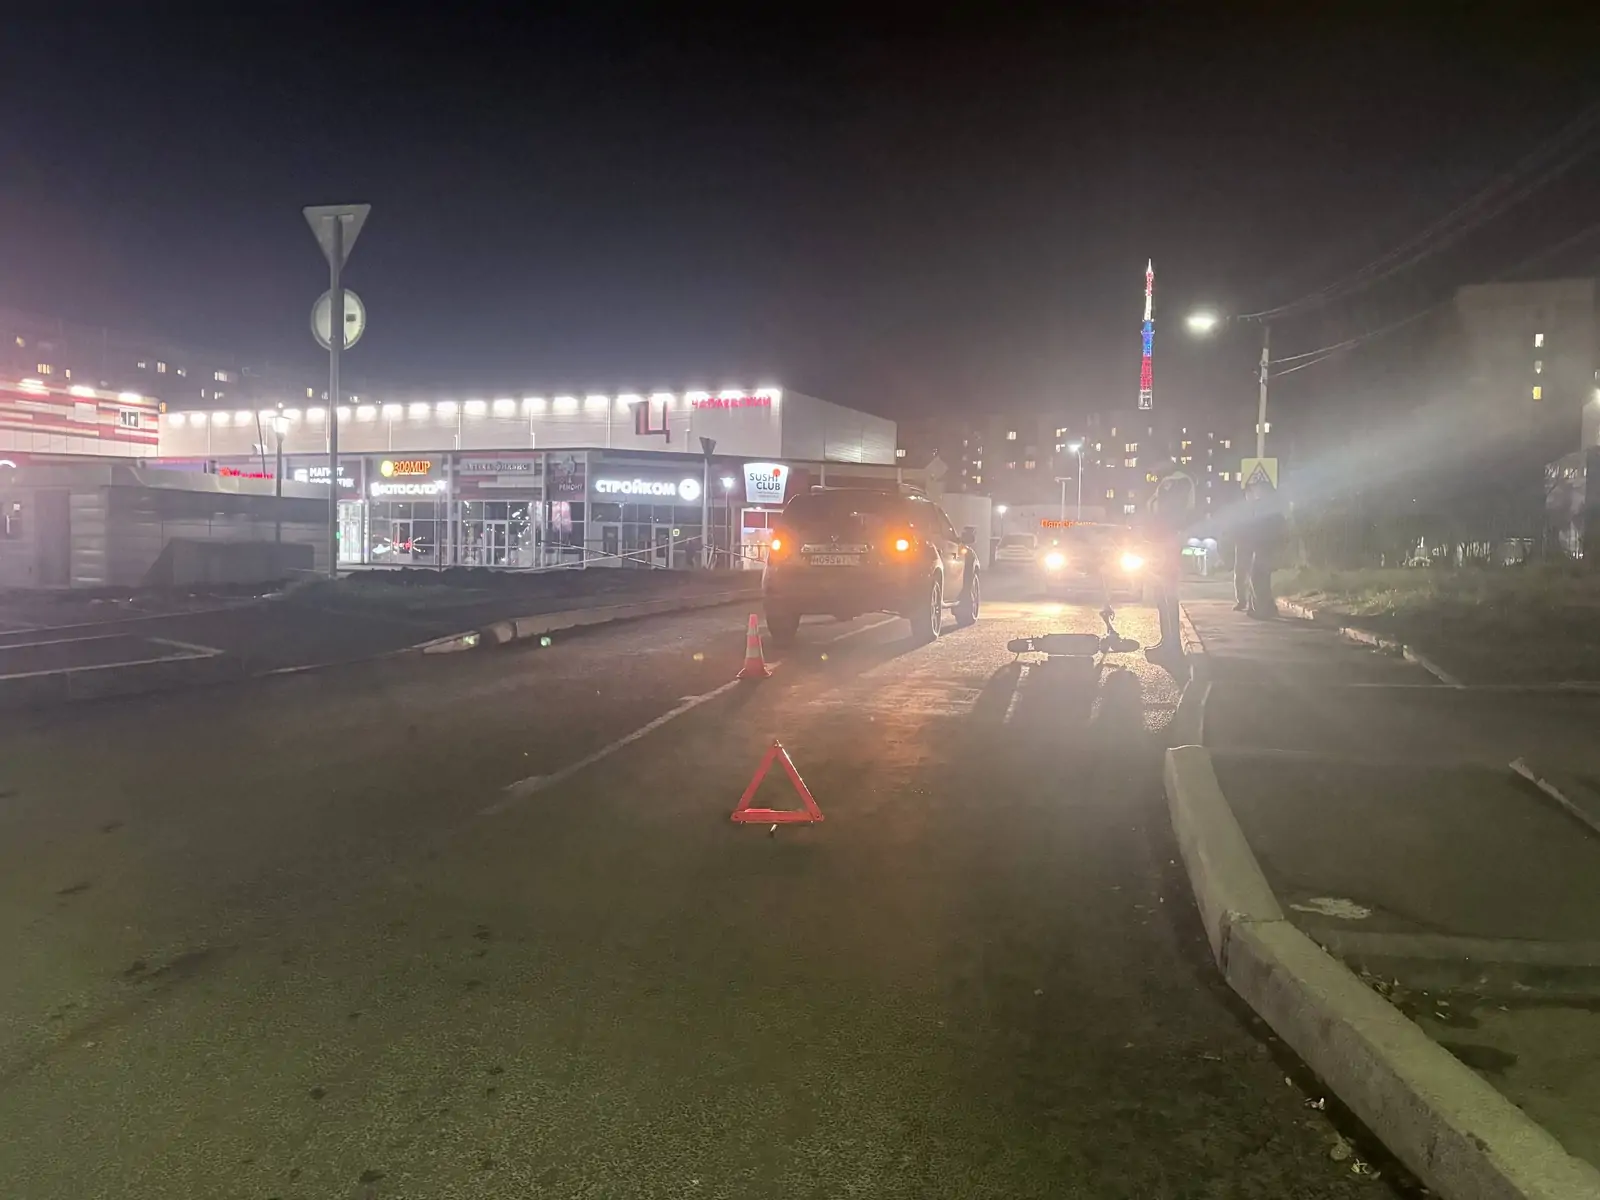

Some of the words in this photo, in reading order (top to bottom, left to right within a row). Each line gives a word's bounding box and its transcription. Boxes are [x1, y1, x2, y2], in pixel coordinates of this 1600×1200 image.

[749, 472, 778, 482] SUSHI
[595, 478, 676, 496] СТРОЙКОМ
[756, 481, 781, 491] CLUB
